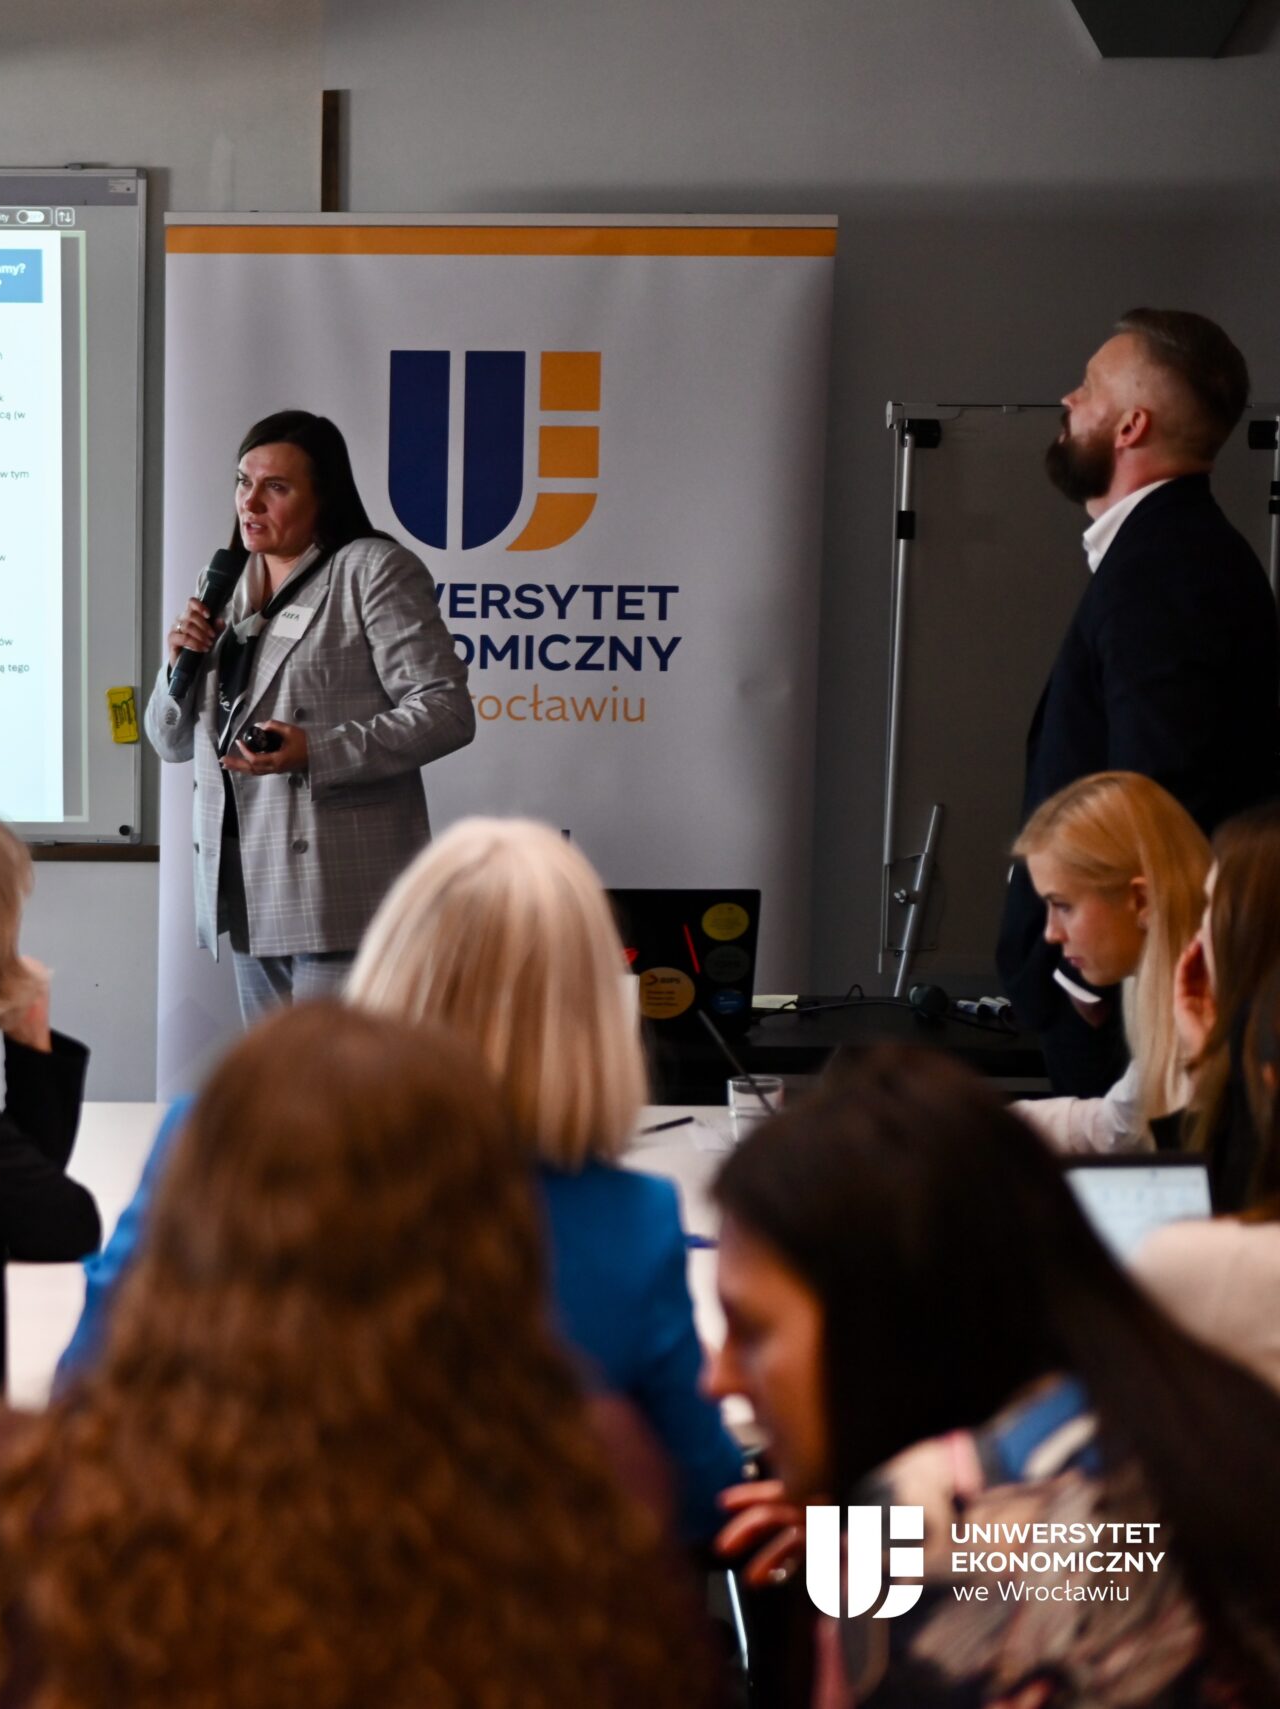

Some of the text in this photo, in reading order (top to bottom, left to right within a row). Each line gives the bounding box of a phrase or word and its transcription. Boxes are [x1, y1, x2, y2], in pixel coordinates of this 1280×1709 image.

[435, 583, 679, 620] ERSYTET
[452, 633, 682, 672] OMICZNY
[470, 683, 646, 722] ocławiu
